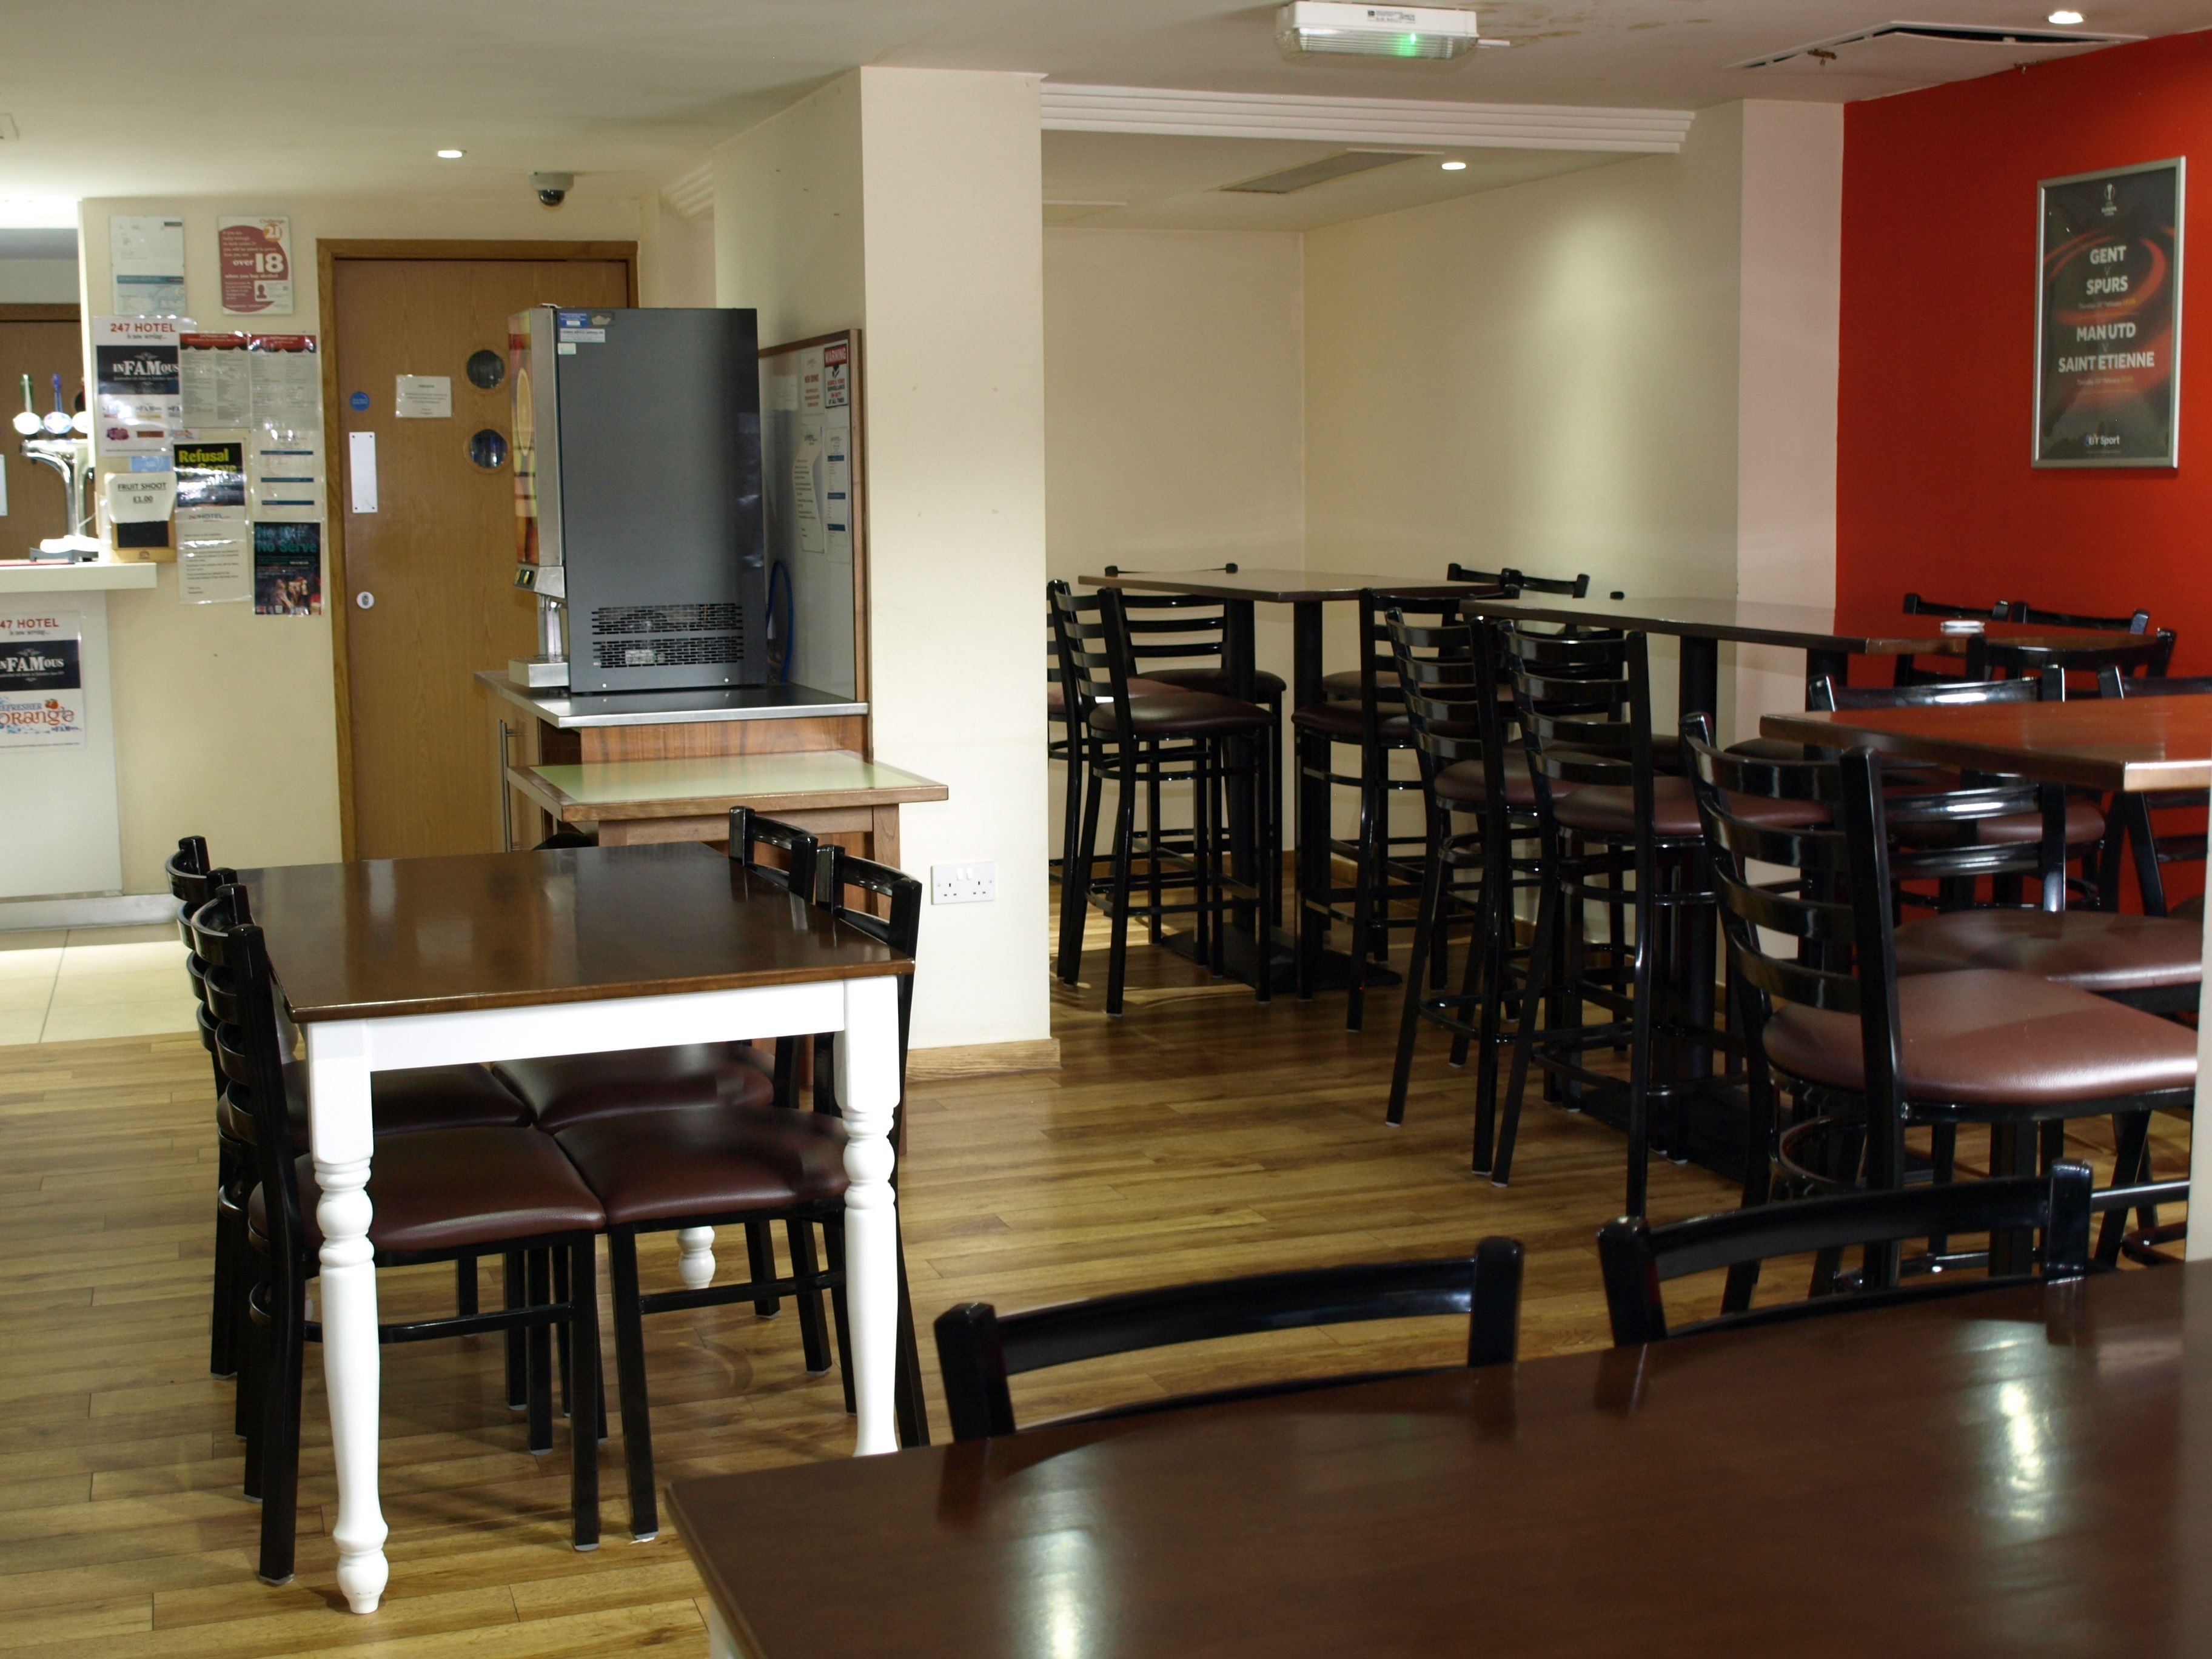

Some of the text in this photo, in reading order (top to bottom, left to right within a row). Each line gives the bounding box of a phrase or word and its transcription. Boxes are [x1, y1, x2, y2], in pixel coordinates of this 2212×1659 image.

[265, 226, 280, 238] 21
[2090, 245, 2127, 265] GENT
[255, 253, 284, 273] 18
[2086, 275, 2128, 295] SPURS
[110, 323, 176, 332] 247 HOTEL
[2076, 322, 2136, 342] MAN UTD
[2058, 351, 2155, 373] SAINT ETIENNE
[2100, 435, 2120, 447] Sport
[178, 448, 229, 463] Refusal
[256, 540, 317, 553] No Serve
[0, 618, 59, 629] 47 HOTEL
[0, 656, 65, 672] NFAMOUS
